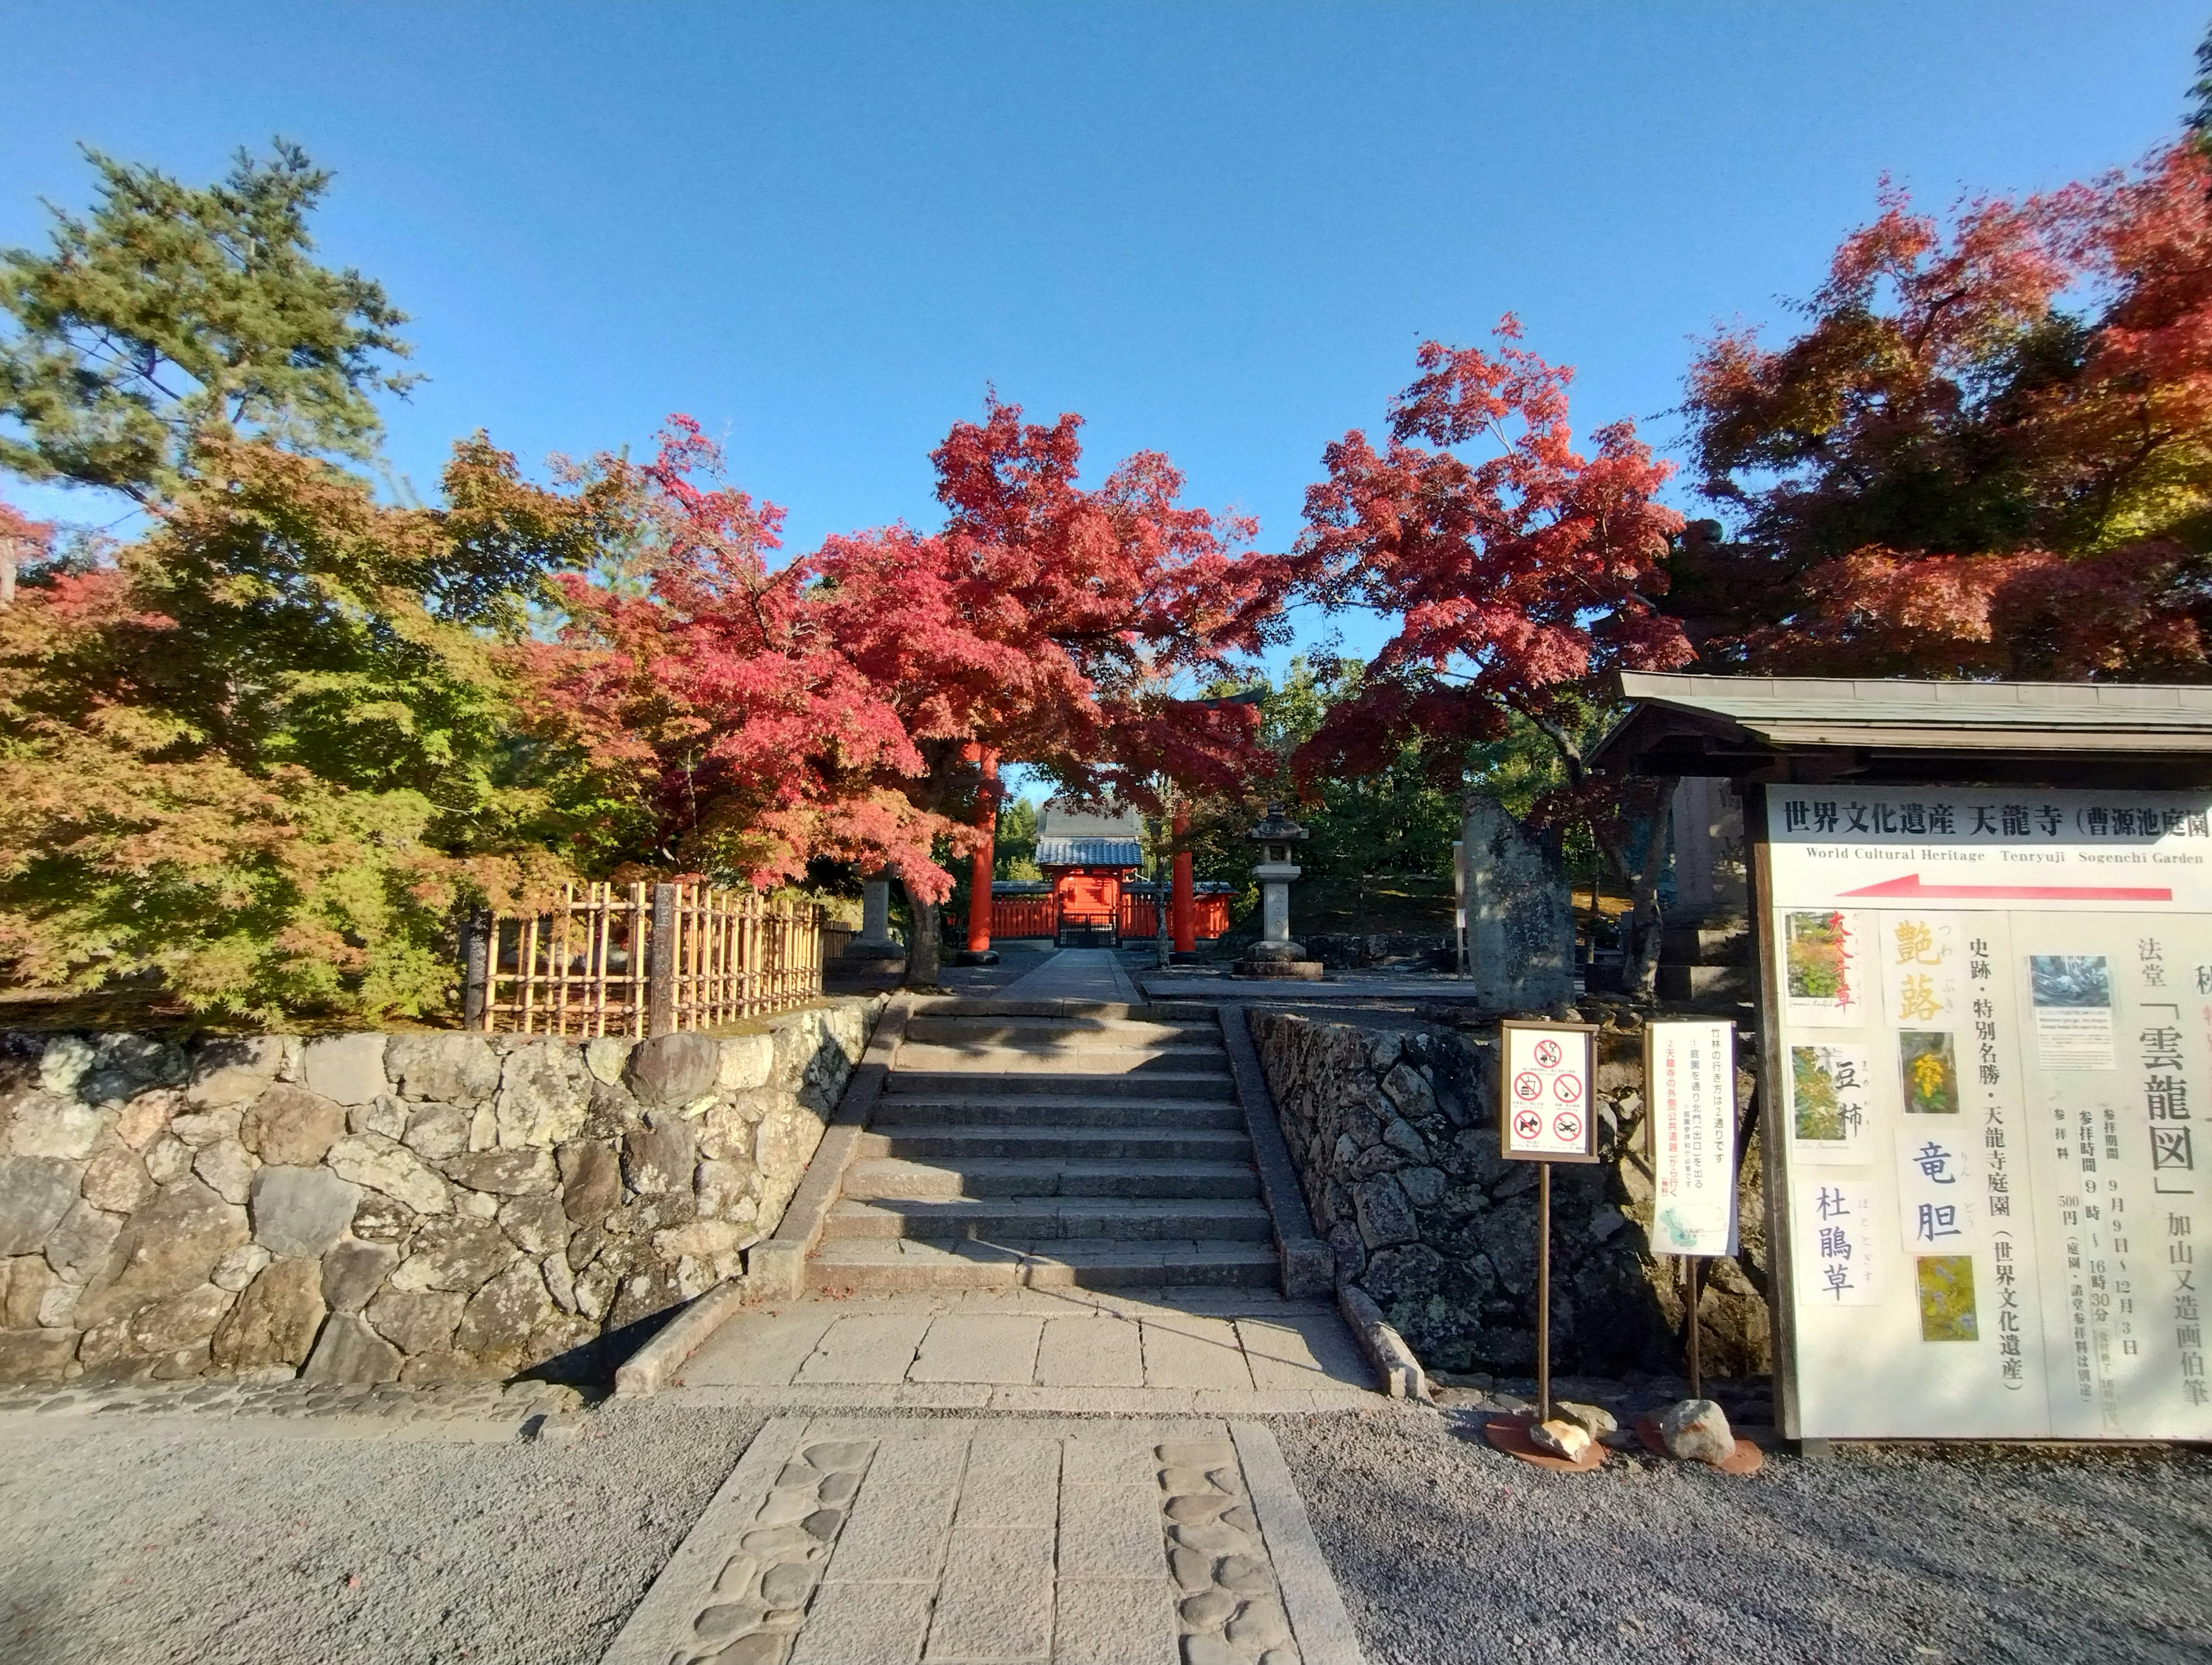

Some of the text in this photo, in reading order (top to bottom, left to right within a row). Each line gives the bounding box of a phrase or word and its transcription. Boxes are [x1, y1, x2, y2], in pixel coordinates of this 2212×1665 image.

[1783, 801, 1956, 835] 世界文化遺産
[1967, 805, 2063, 836] 天龍寺
[1806, 847, 2203, 864] World Cultural Heritage Tenryuji Sogenchi Garden
[1711, 1028, 1724, 1163] 竹林の行き方は2通りです
[1836, 1061, 1862, 1138] 豆柿
[2054, 1108, 2069, 1159] 参拝料
[2079, 1110, 2097, 1172] 参拝時間
[2104, 1109, 2119, 1160] 参拝期間
[1912, 1141, 1962, 1242] 竜胆
[2138, 938, 2210, 1406] 法堂 「雲龍図」 加山又造画伯筆
[1816, 1186, 1854, 1301] 杜鵑草
